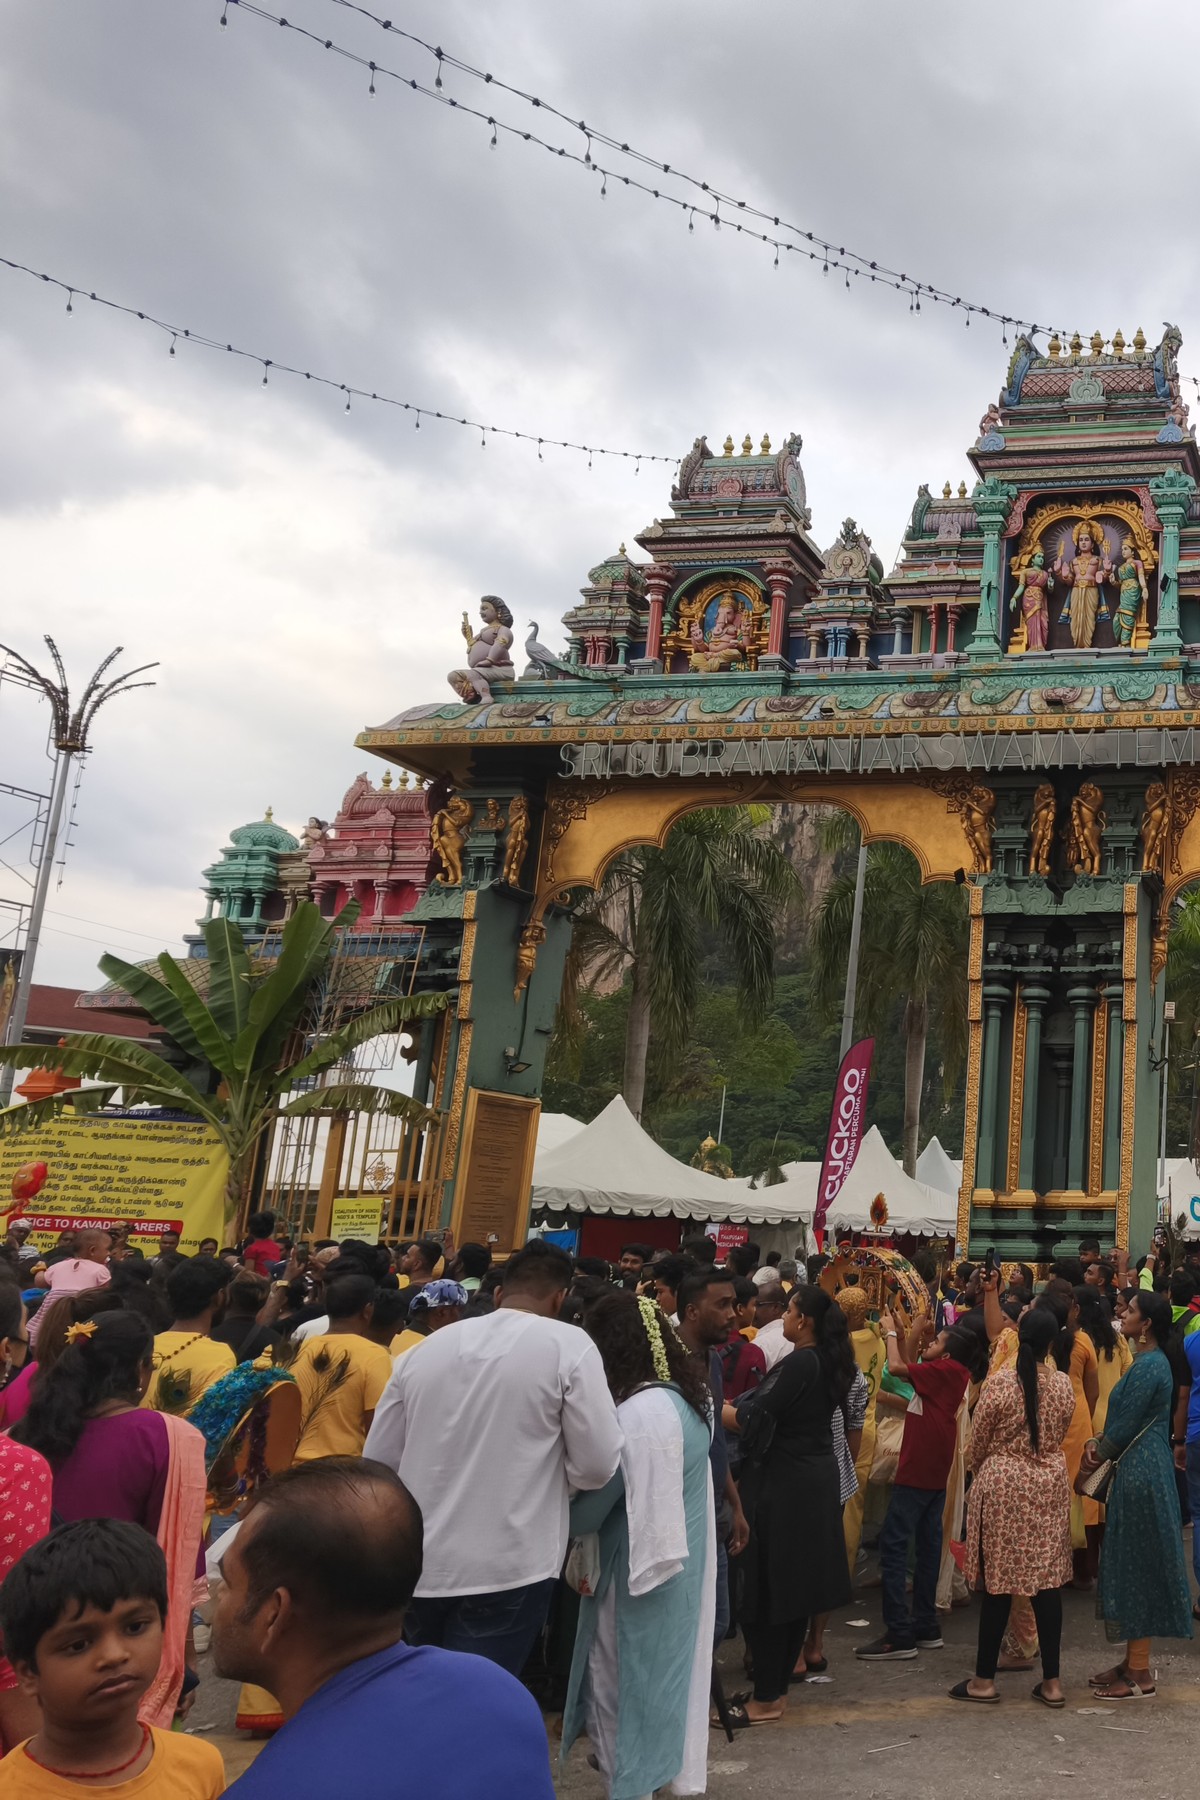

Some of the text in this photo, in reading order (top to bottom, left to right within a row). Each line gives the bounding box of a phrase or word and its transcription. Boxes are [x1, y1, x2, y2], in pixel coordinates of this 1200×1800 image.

[558, 740, 613, 780] SRI
[629, 734, 922, 778] SUBRAMANIAR
[936, 729, 1095, 772] SWAMY
[825, 1068, 860, 1200] CUCKOO
[842, 1140, 856, 1184] DAFTARAN
[851, 1096, 862, 1137] PERCUMA
[26, 1218, 51, 1227] TICE
[55, 1219, 69, 1227] TO
